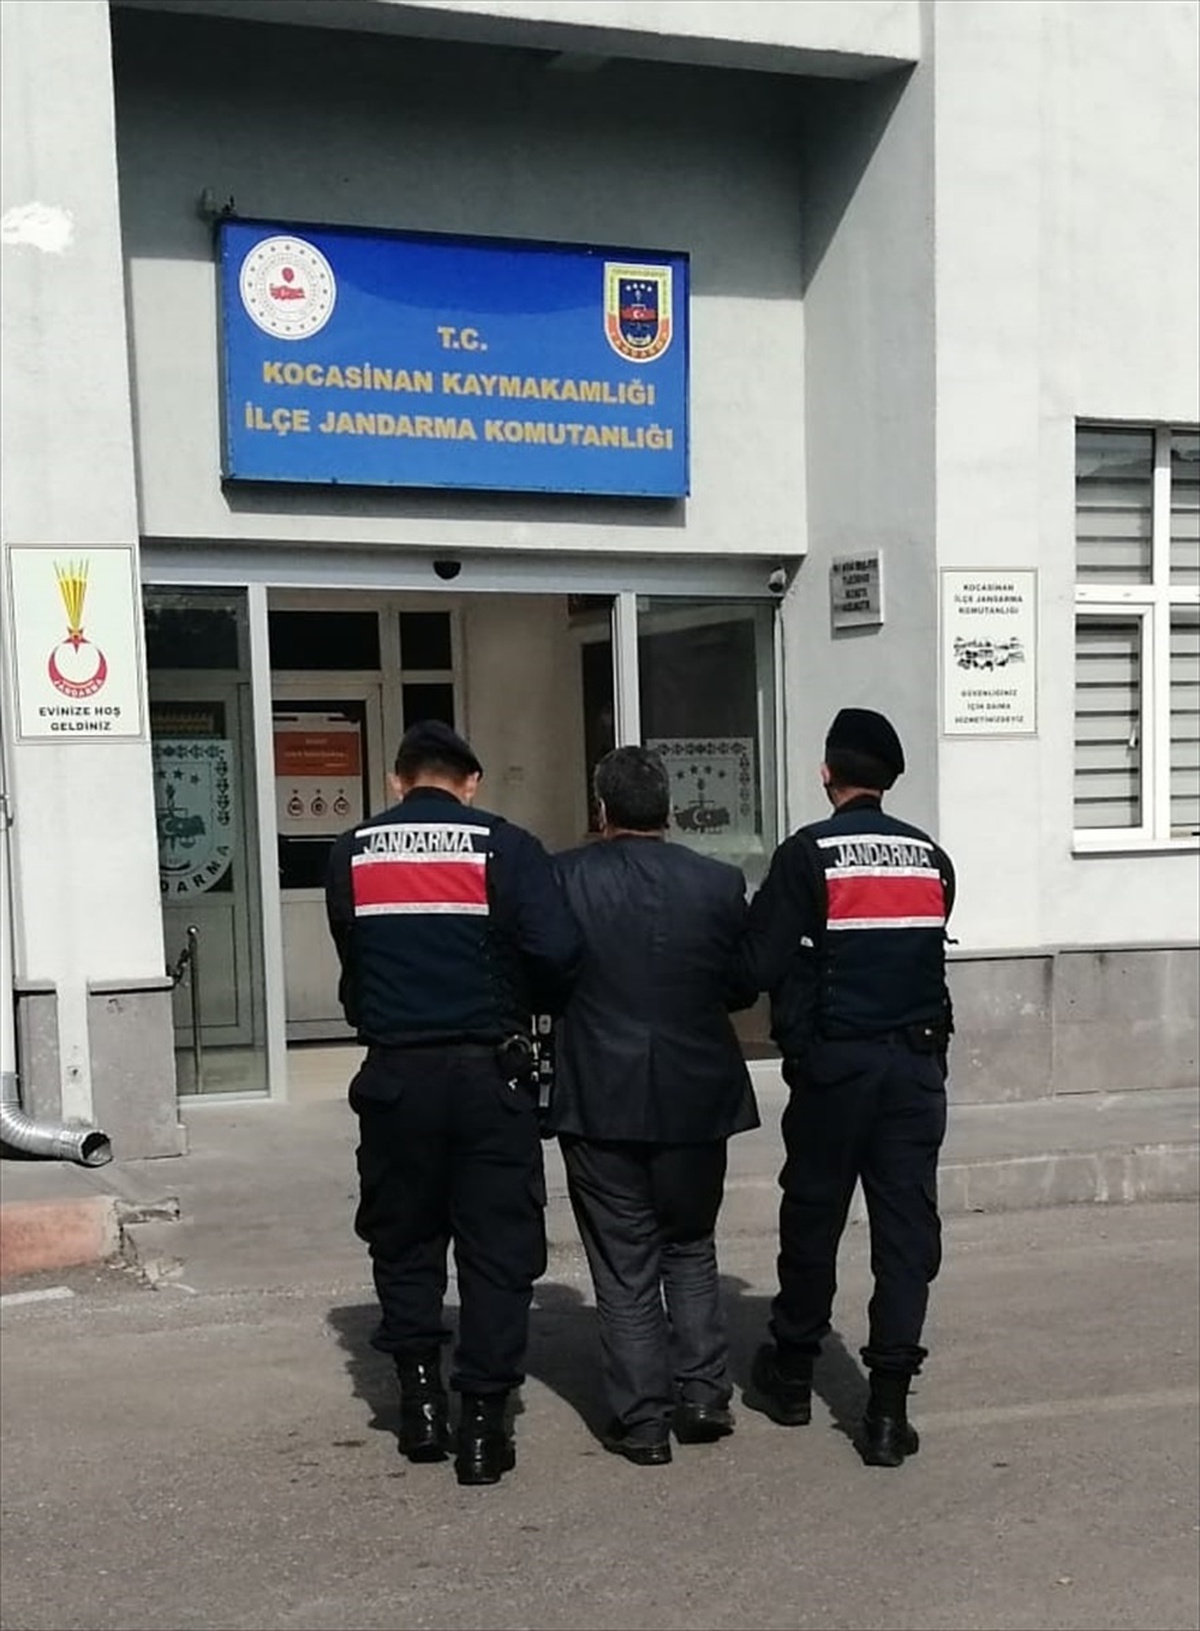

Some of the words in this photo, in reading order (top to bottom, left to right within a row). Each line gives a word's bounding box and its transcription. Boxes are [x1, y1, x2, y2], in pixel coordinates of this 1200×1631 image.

[437, 326, 487, 350] T.C.
[262, 361, 433, 392] KOCASİNAN
[442, 372, 655, 405] KAYMAKAMLIĞI
[245, 402, 310, 436] İLÇE
[319, 411, 477, 441] JANDARMA
[484, 420, 674, 450] KOMUTANLIĞI
[39, 706, 91, 717] EVİNİZE
[94, 706, 121, 718] HOŞ
[50, 721, 112, 731] GELDİNİZ
[363, 830, 474, 854] JANDARMA
[834, 842, 932, 867] JANDARMA
[160, 845, 230, 894] DARMA
